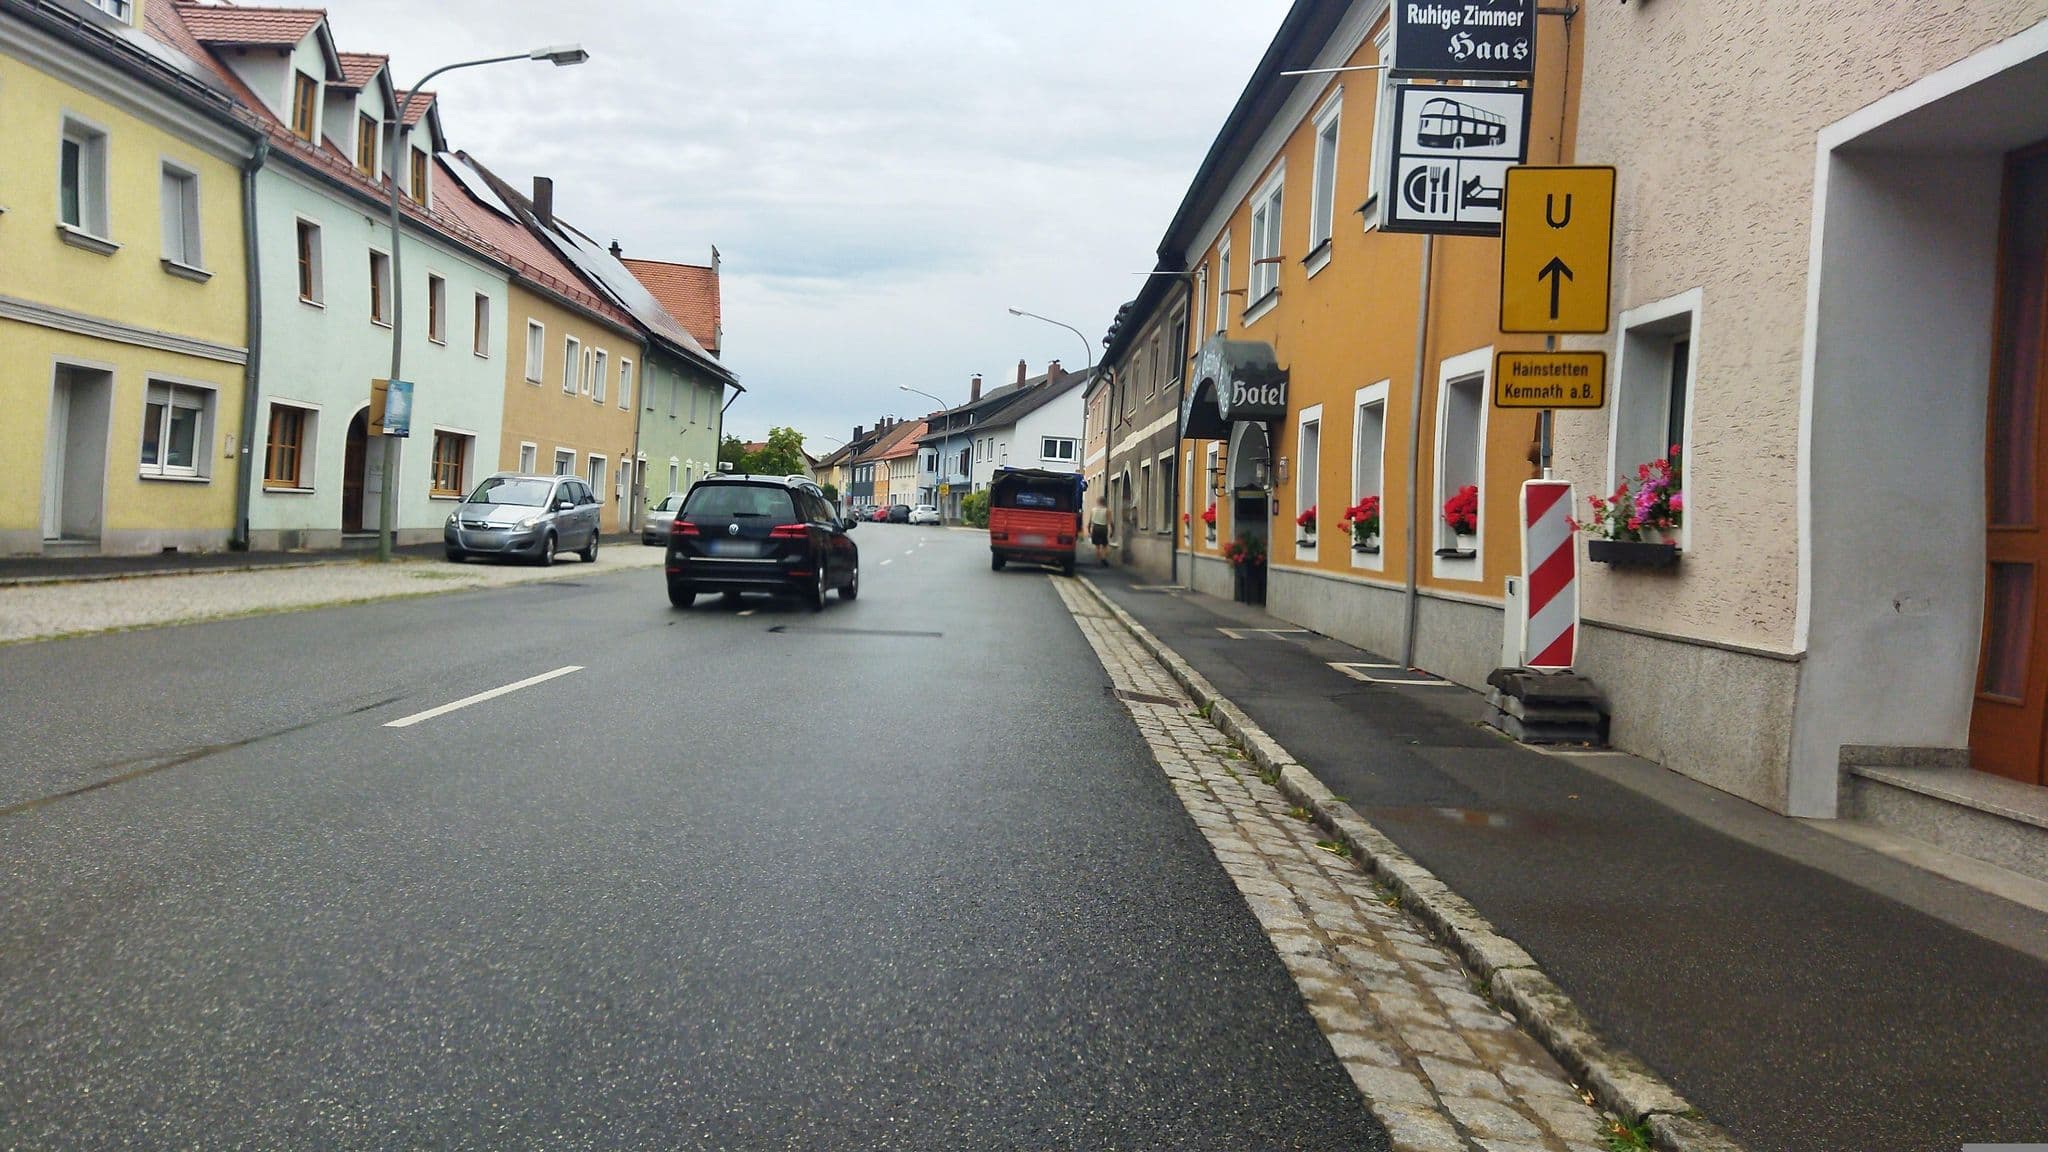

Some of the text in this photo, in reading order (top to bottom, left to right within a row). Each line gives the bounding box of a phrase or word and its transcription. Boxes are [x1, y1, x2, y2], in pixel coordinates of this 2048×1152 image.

[1407, 3, 1524, 30] Ruhige Zimmer
[1448, 31, 1528, 62] Haas
[1546, 193, 1572, 229] U
[1513, 361, 1588, 376] Hainstetten
[1232, 380, 1286, 406] Hotel
[1505, 383, 1563, 399] Kemnath
